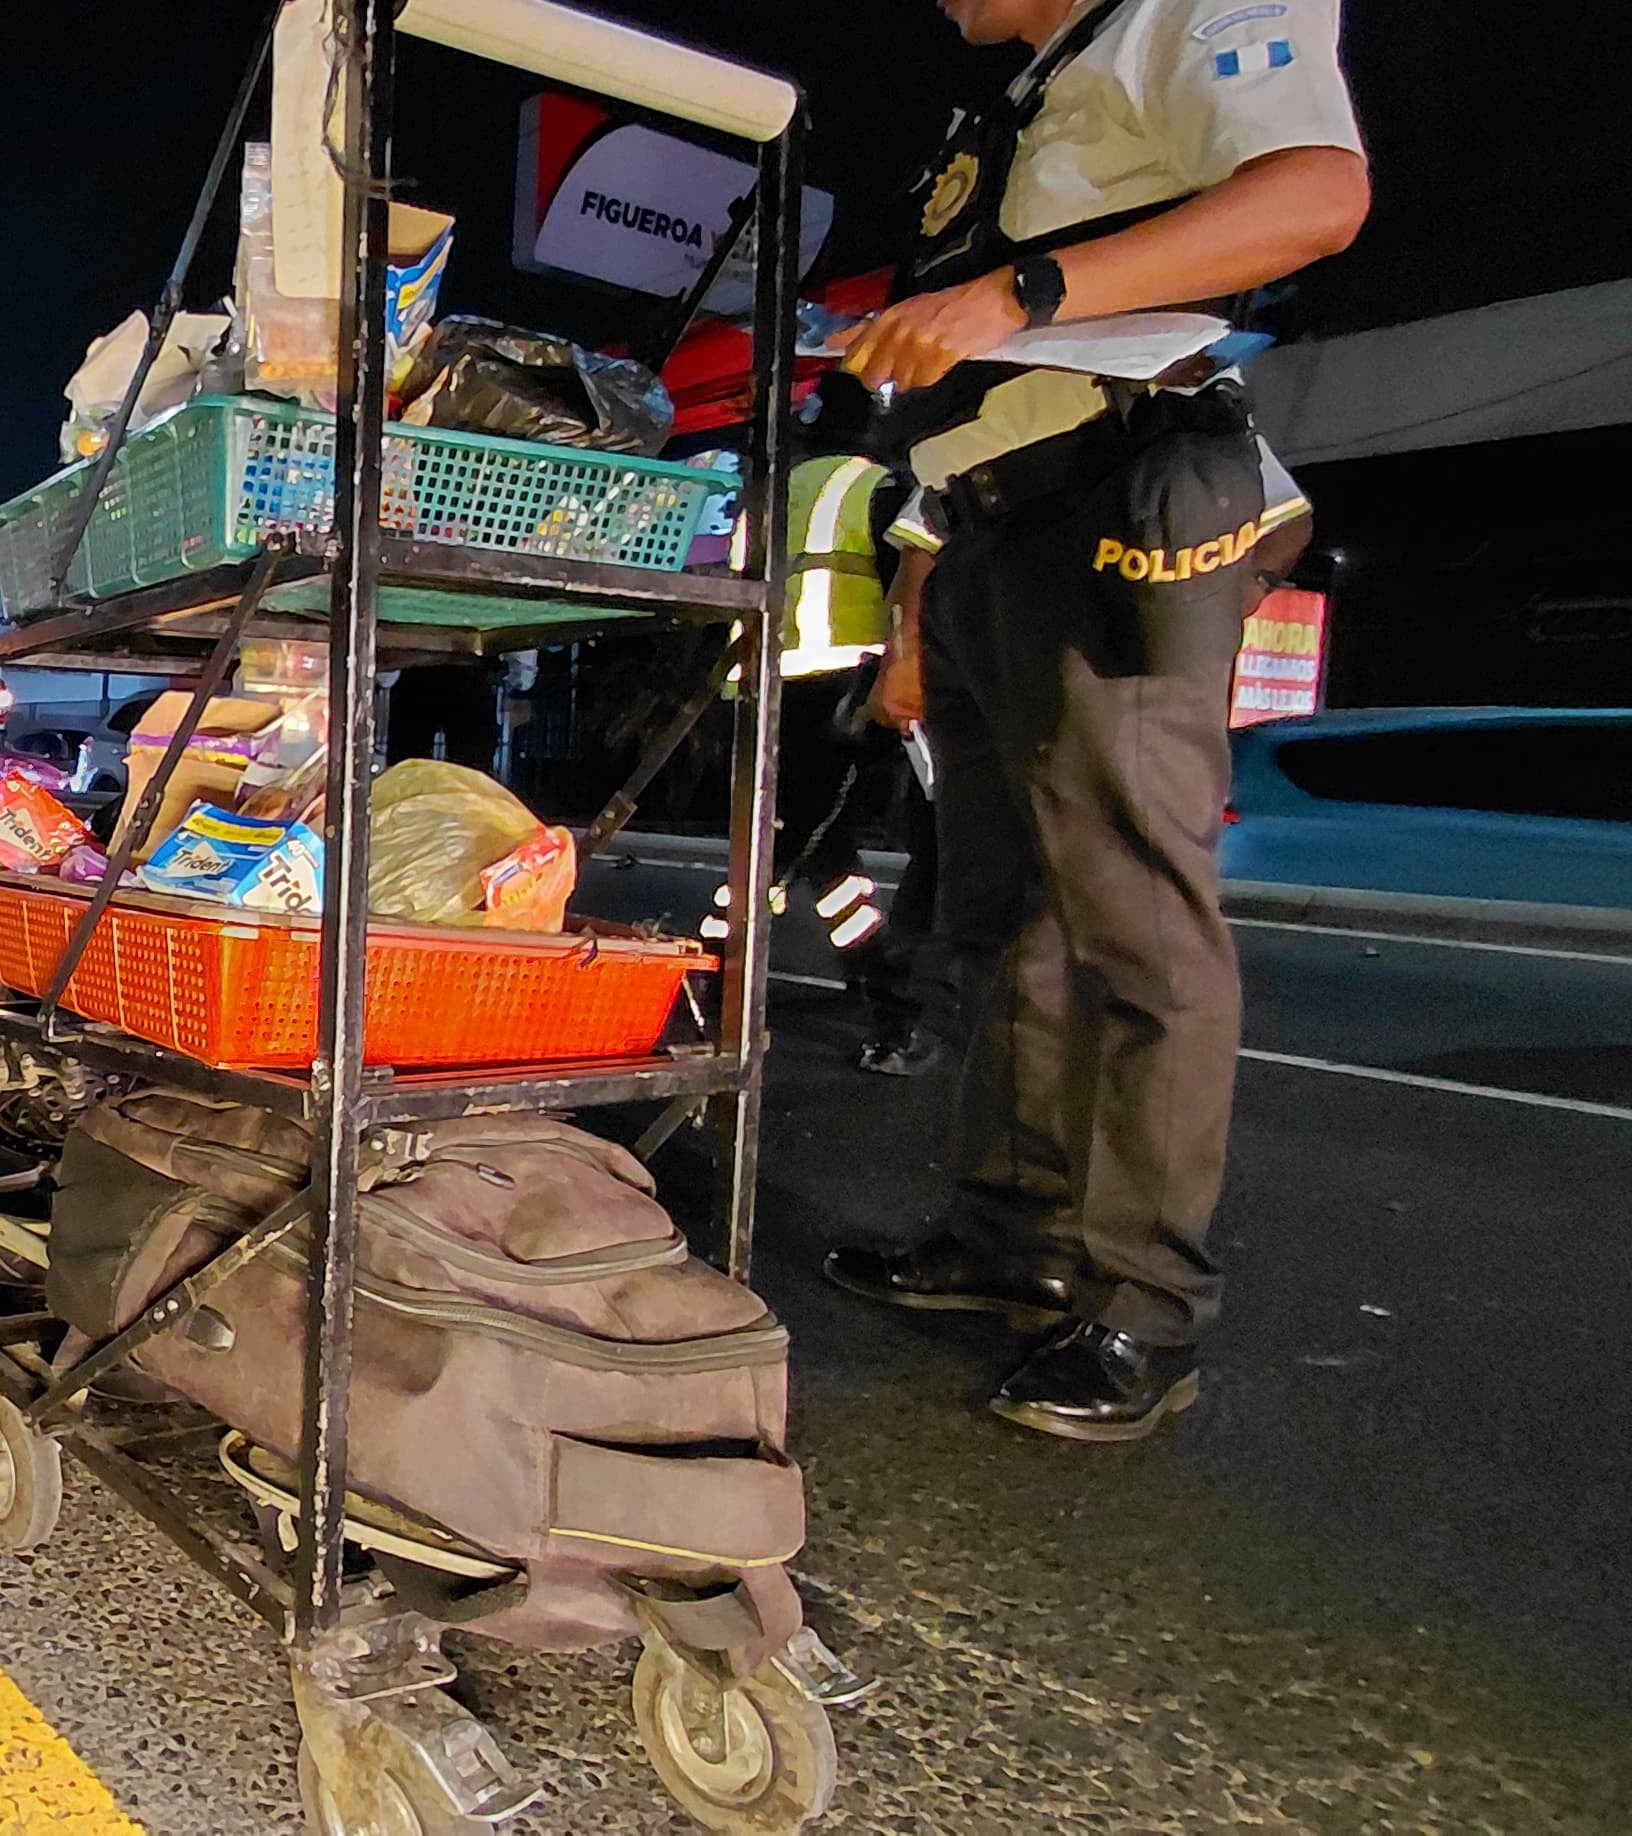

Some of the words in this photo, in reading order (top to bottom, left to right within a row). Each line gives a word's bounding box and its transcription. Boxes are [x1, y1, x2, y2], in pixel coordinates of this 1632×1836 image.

[580, 191, 703, 249] FIGUEROA
[1092, 521, 1258, 583] POLICIA
[1241, 618, 1317, 655] AHORA
[0, 808, 53, 859] Trident
[172, 849, 230, 873] Trident
[262, 854, 313, 912] Trid
